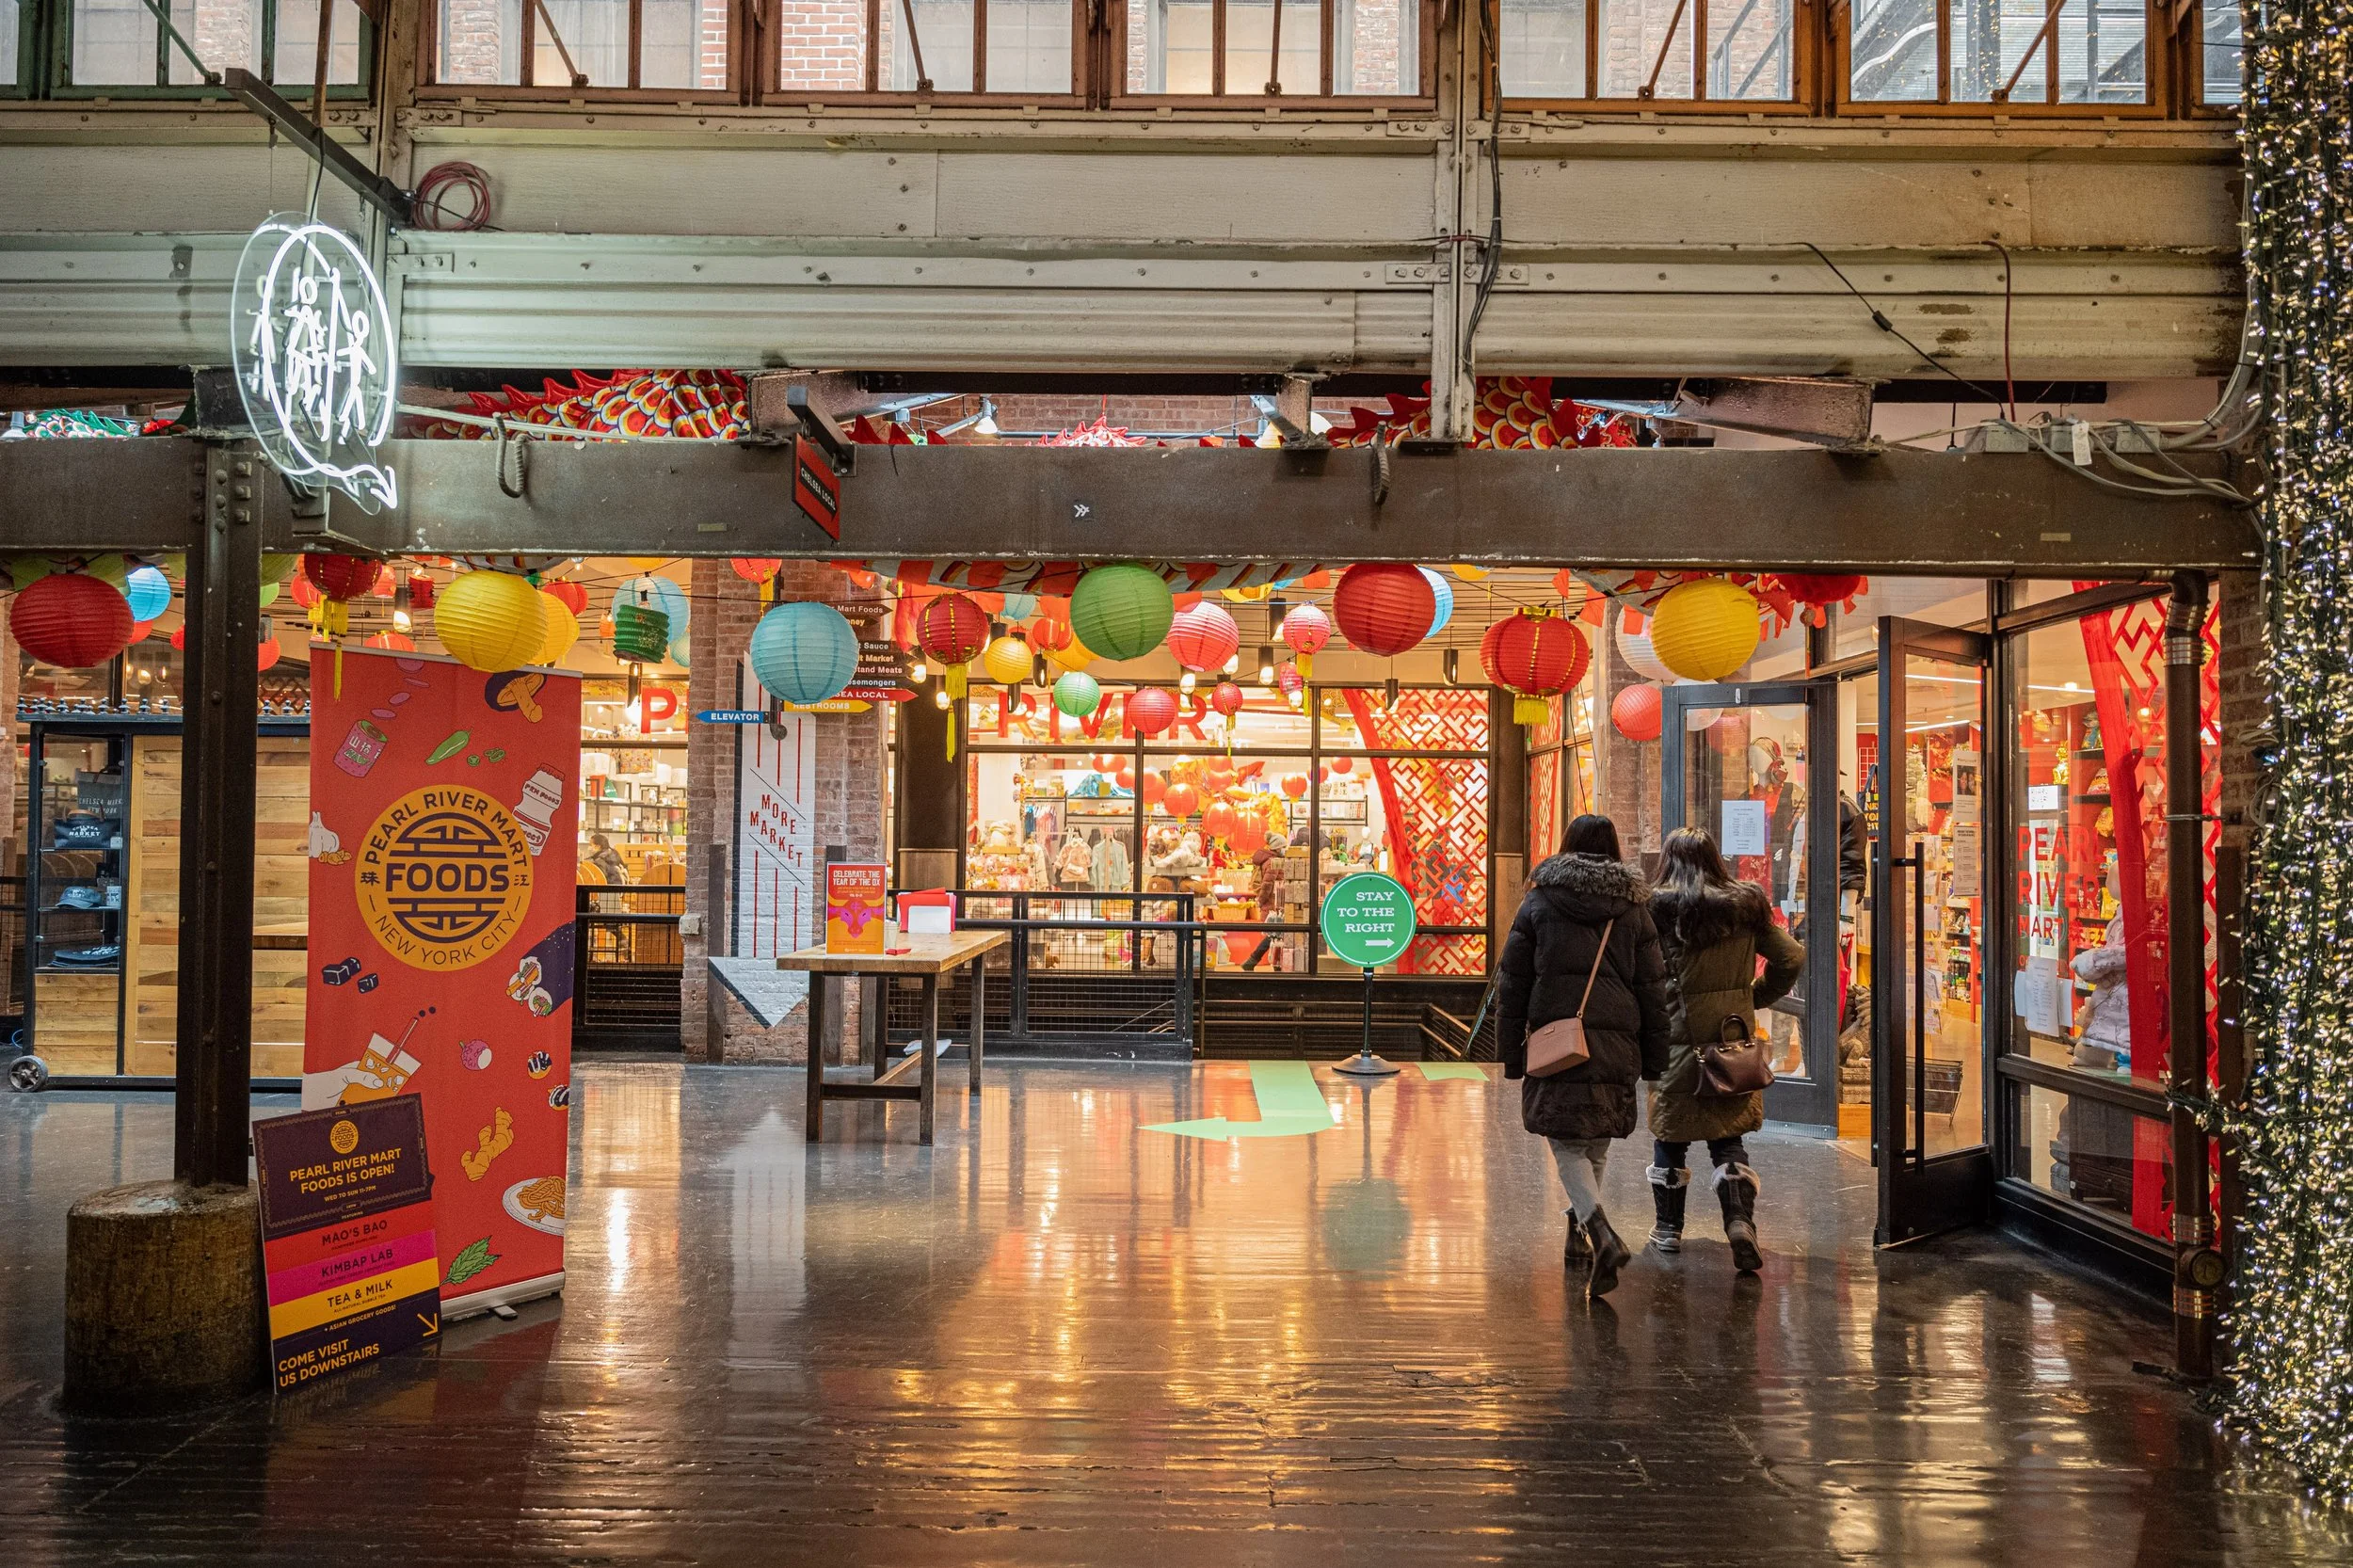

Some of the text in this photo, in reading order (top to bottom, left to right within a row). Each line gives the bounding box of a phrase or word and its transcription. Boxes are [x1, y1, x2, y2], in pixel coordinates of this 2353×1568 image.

[801, 467, 836, 510] CHELSEA LOCAL
[847, 618, 865, 627] oney
[858, 605, 883, 614] Foods
[865, 654, 894, 663] Market
[848, 679, 896, 687] esemongers
[856, 691, 888, 699] LOCAL
[711, 712, 760, 721] ELEVATOR
[761, 794, 796, 835] MORE
[364, 791, 527, 867] PEARL RIVER MART
[750, 810, 803, 868] MARKET
[2018, 826, 2107, 863] PEARL
[385, 862, 510, 892] FOODS
[833, 870, 881, 878] CELEBRATE THE
[872, 878, 881, 887] OX
[1355, 891, 1395, 902] STAY
[2018, 871, 2100, 911] RIVER
[1337, 907, 1395, 918] TO THE
[375, 911, 516, 966] NEW YORK CITY
[1344, 922, 1395, 934] RIGHT
[2017, 914, 2064, 940] MART
[335, 1132, 355, 1142] FOODS
[290, 1164, 330, 1182] PEARL
[332, 1155, 367, 1172] RIVER
[370, 1148, 402, 1163] MART
[300, 1163, 395, 1194] FOODS IS OPEN!
[322, 1220, 388, 1245] MAO'S BAO
[321, 1256, 367, 1277] KIMBAP
[370, 1248, 393, 1262] LAB
[327, 1292, 351, 1308] TEA
[354, 1288, 362, 1300] &
[365, 1279, 393, 1297] MILK
[328, 1320, 347, 1332] ASIAN
[347, 1311, 375, 1325] GROCERY
[375, 1304, 396, 1315] GOODS!
[279, 1338, 349, 1372] COME VISIT
[280, 1343, 380, 1387] US DOWNSTAIRS
